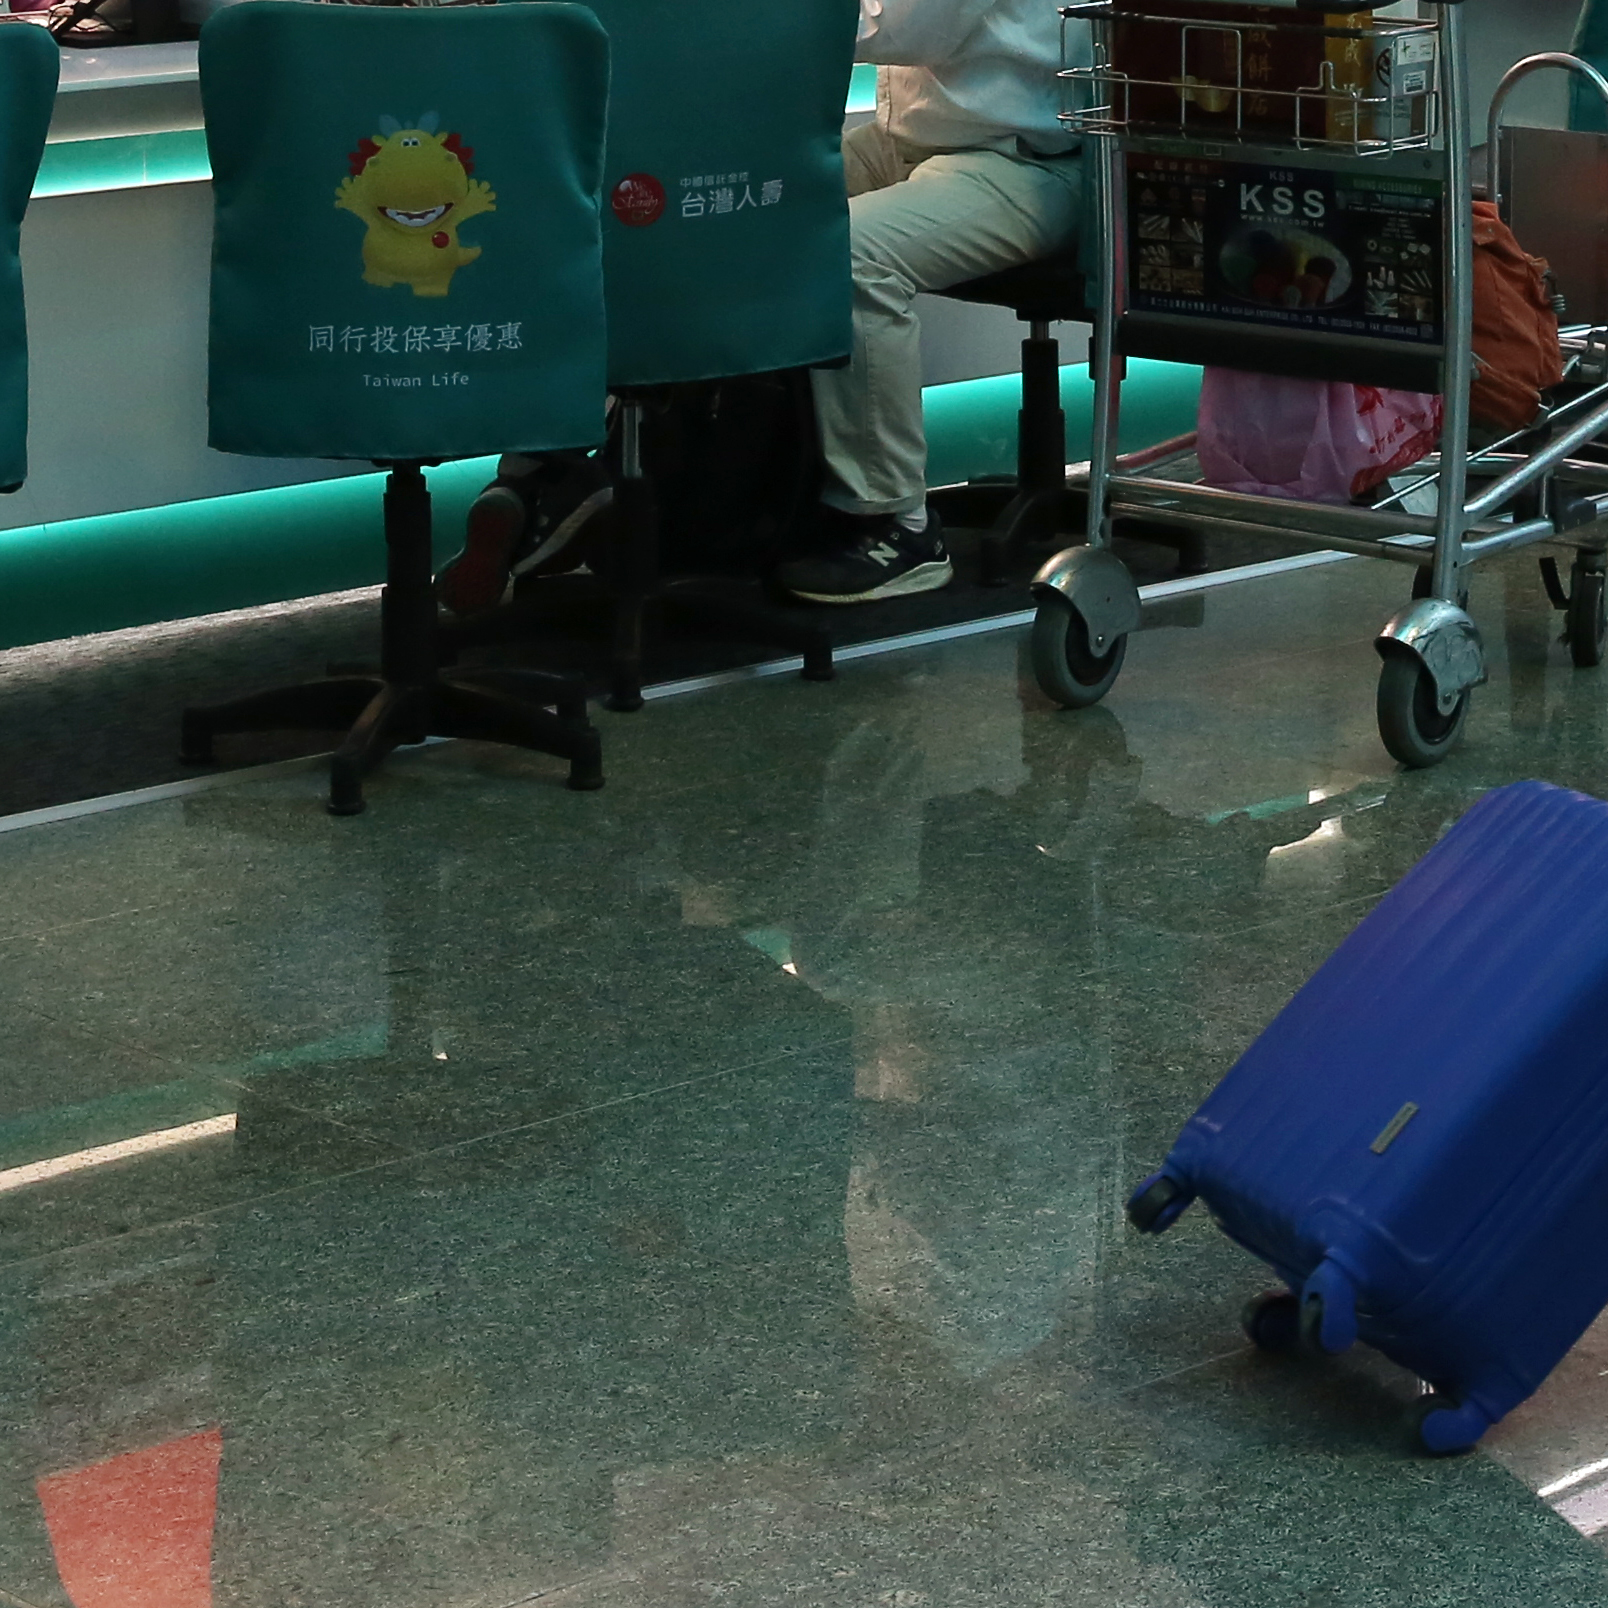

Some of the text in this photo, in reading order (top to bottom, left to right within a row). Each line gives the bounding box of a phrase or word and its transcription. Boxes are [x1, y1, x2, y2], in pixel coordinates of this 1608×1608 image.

[681, 179, 784, 218] 台灣人壽
[1240, 182, 1326, 219] KSS
[308, 321, 524, 354] 同行投保享優惠
[362, 372, 470, 389] Taiwan Life
